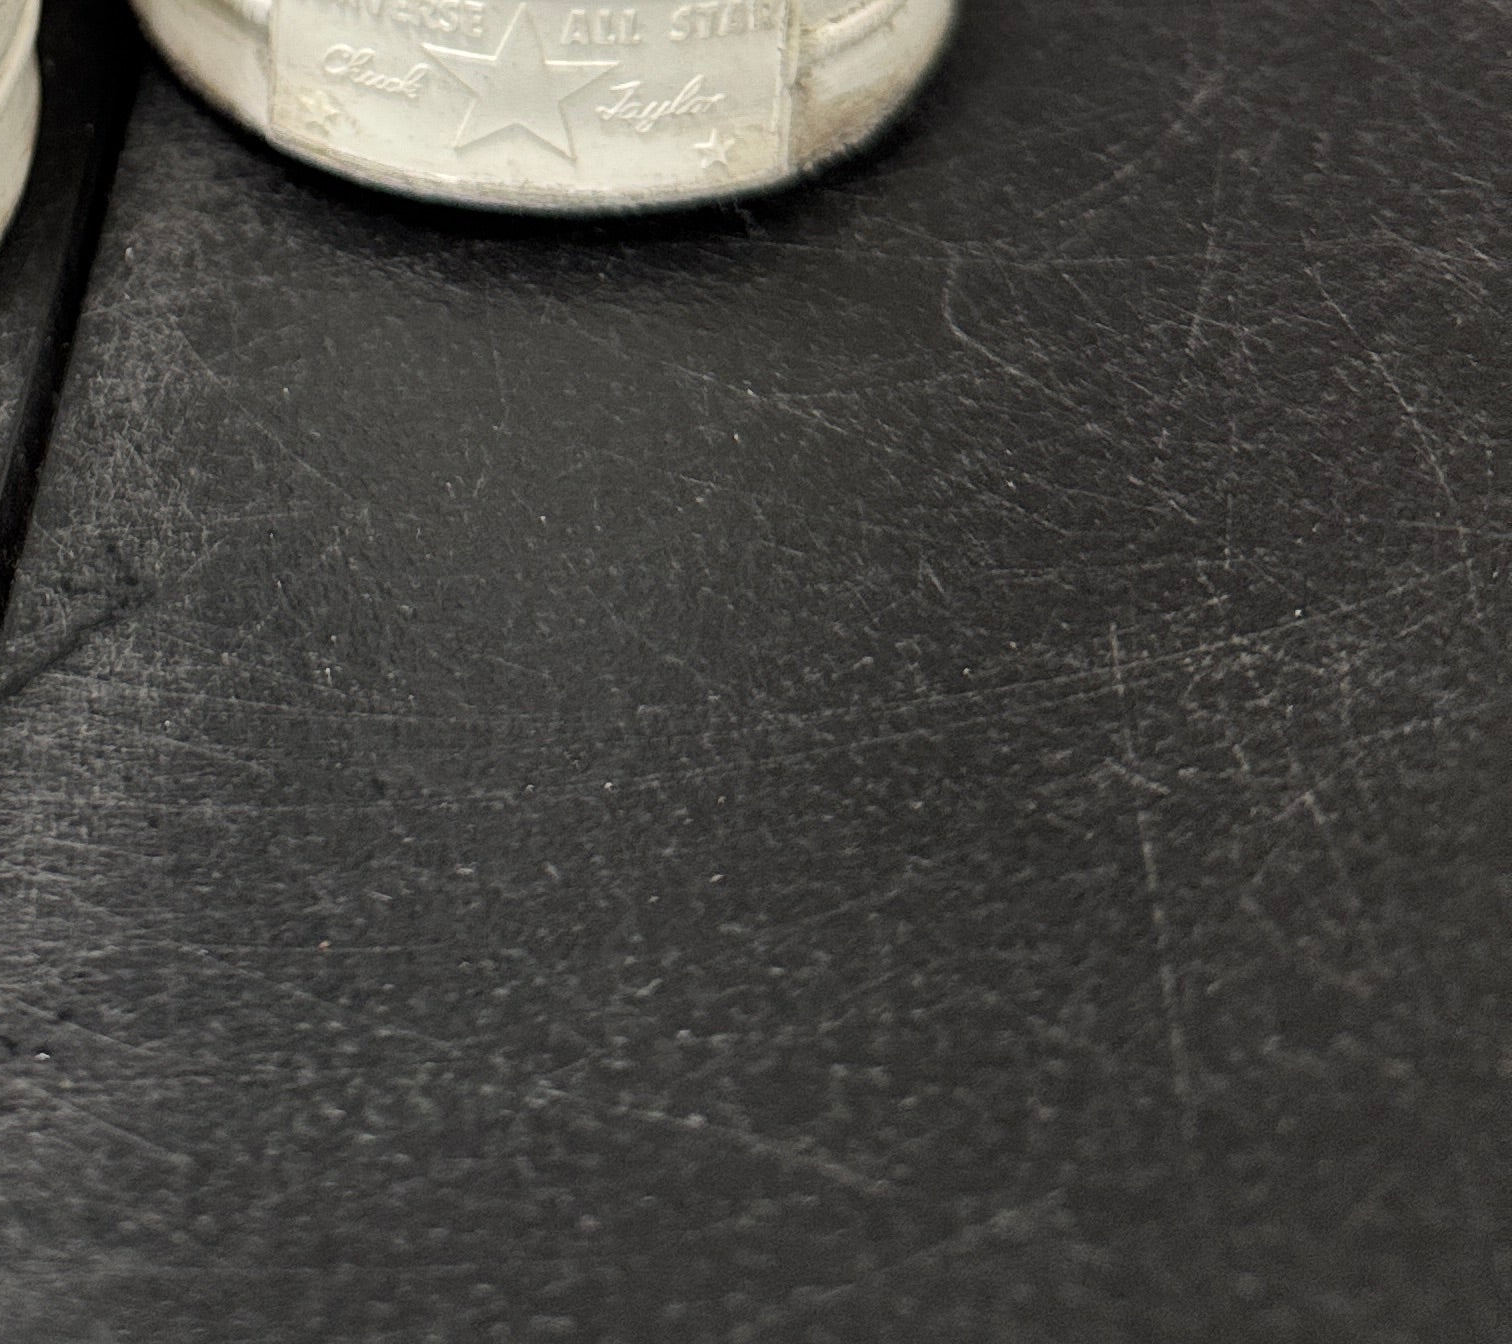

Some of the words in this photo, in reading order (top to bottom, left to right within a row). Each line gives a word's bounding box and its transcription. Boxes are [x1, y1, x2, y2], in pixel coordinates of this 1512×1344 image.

[559, 7, 642, 46] ALL
[322, 41, 431, 100] Chuck
[595, 73, 728, 134] Taylor
